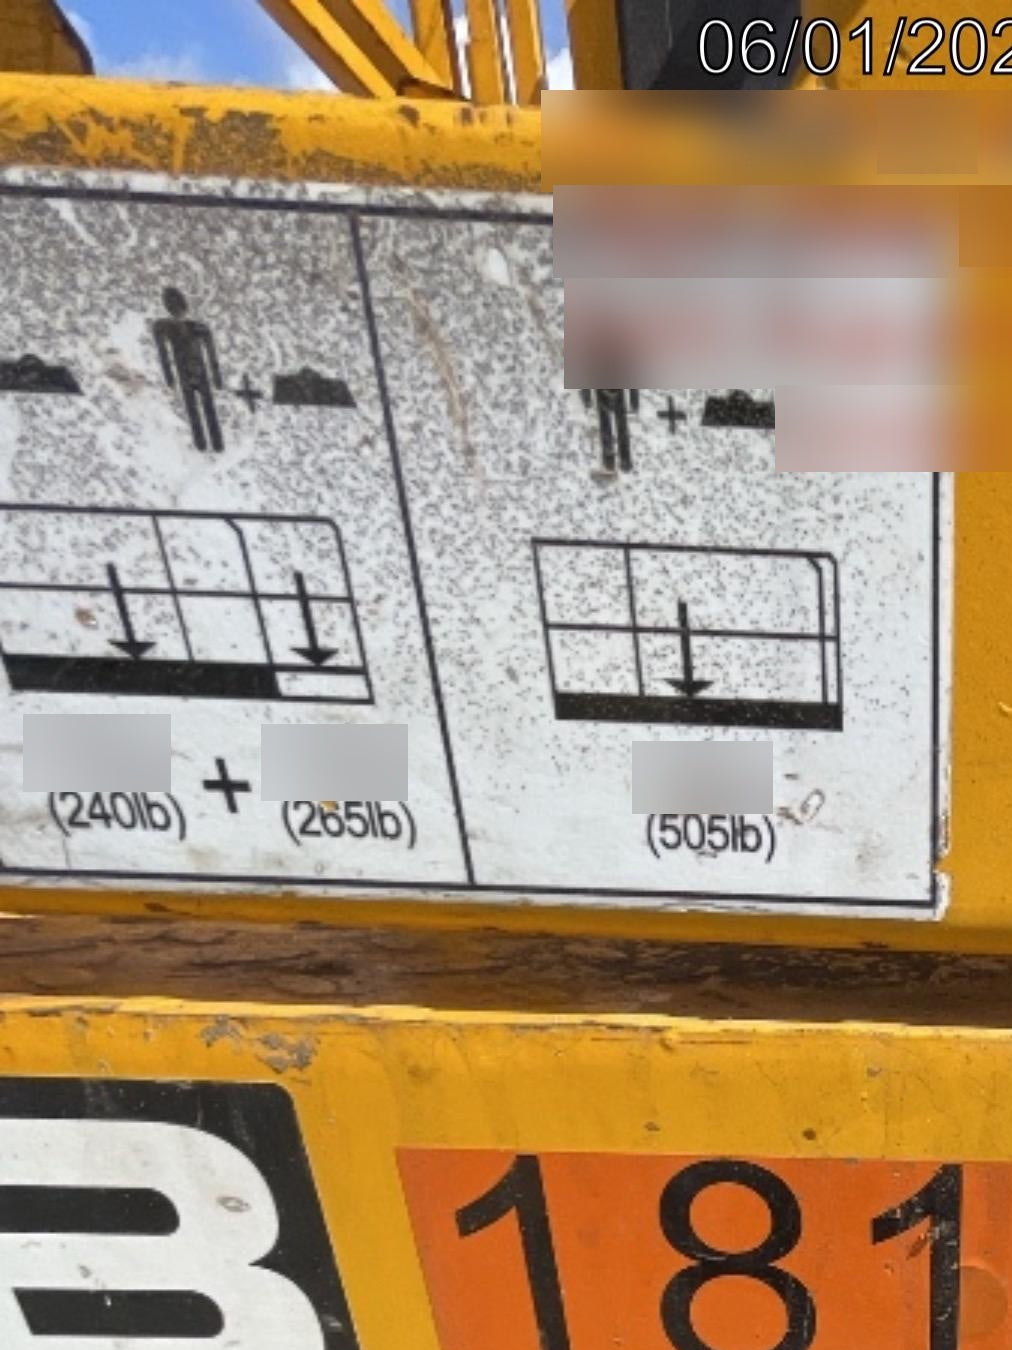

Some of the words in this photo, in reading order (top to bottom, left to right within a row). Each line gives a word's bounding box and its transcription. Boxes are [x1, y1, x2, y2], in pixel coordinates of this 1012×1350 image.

[48, 792, 187, 842] (240lb)
[282, 801, 417, 850] (265lb)
[646, 813, 776, 865] (505lb)
